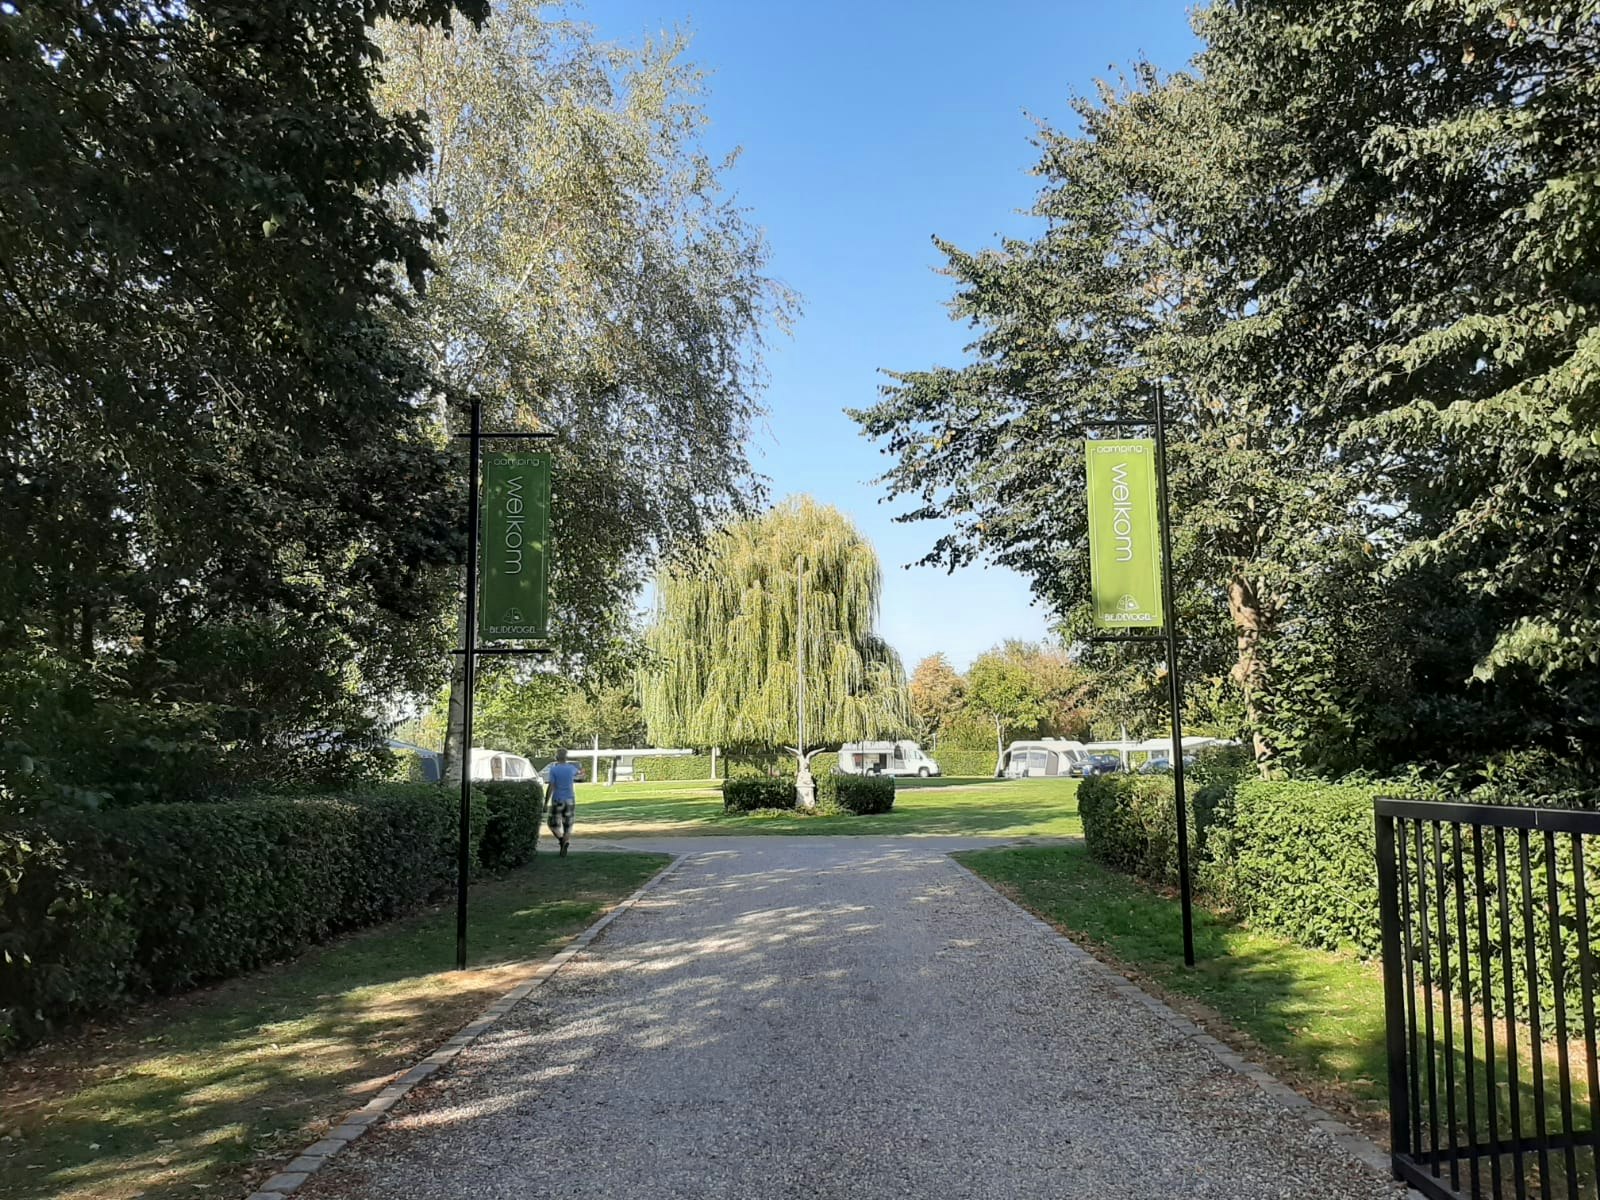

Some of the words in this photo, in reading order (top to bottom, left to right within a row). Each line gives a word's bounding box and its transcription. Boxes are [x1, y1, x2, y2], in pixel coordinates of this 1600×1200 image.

[494, 458, 540, 467] camping
[1097, 445, 1143, 454] camping
[504, 476, 526, 575] welkom
[1111, 463, 1133, 562] welkom
